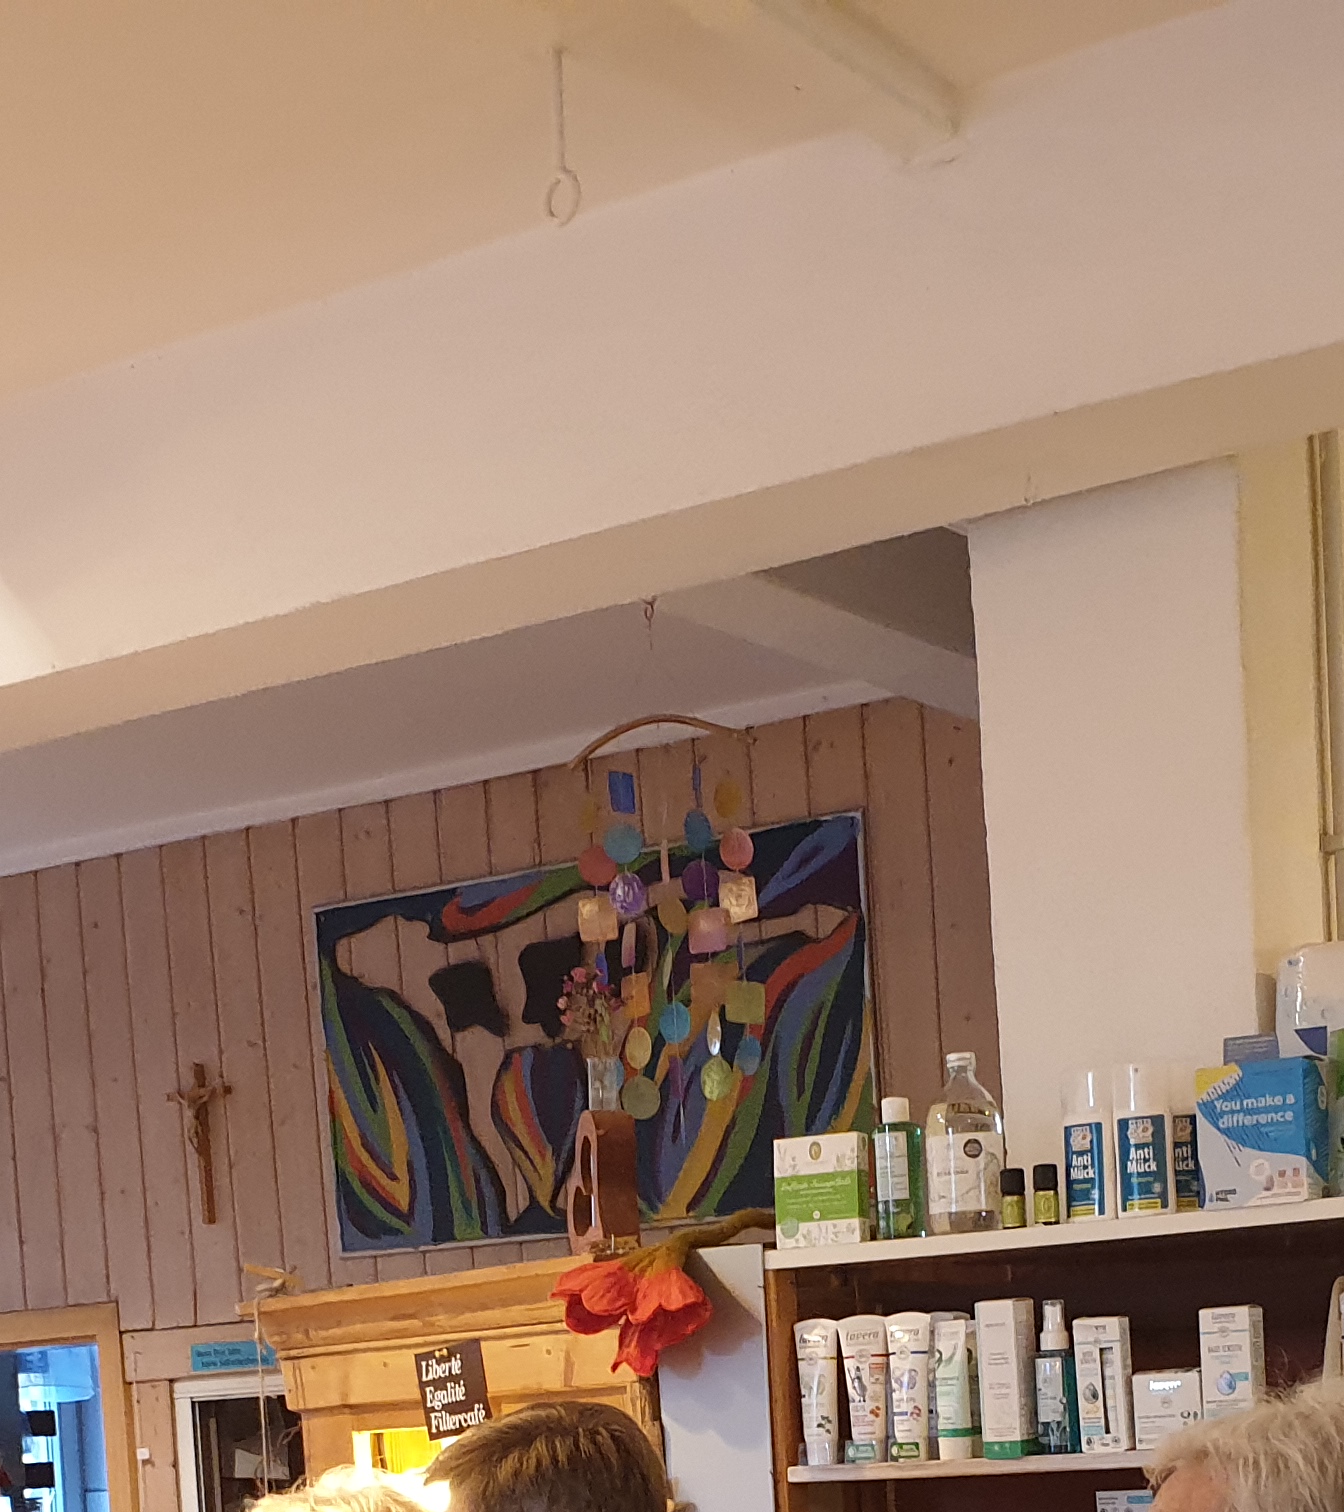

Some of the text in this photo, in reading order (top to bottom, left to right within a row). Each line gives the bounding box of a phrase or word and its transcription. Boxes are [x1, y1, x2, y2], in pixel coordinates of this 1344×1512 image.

[1214, 1093, 1295, 1113] You make a
[1218, 1111, 1294, 1129] difference
[1129, 1145, 1154, 1161] Anti
[1174, 1144, 1192, 1158] nti
[1071, 1152, 1092, 1167] Anti
[1127, 1159, 1158, 1174] Mück
[1175, 1159, 1195, 1171] ück
[1070, 1165, 1095, 1180] Mück
[846, 1330, 880, 1341] lavera
[421, 1353, 462, 1382] Liberté
[425, 1380, 466, 1411] Egalité
[429, 1403, 486, 1433] Filtercafé
